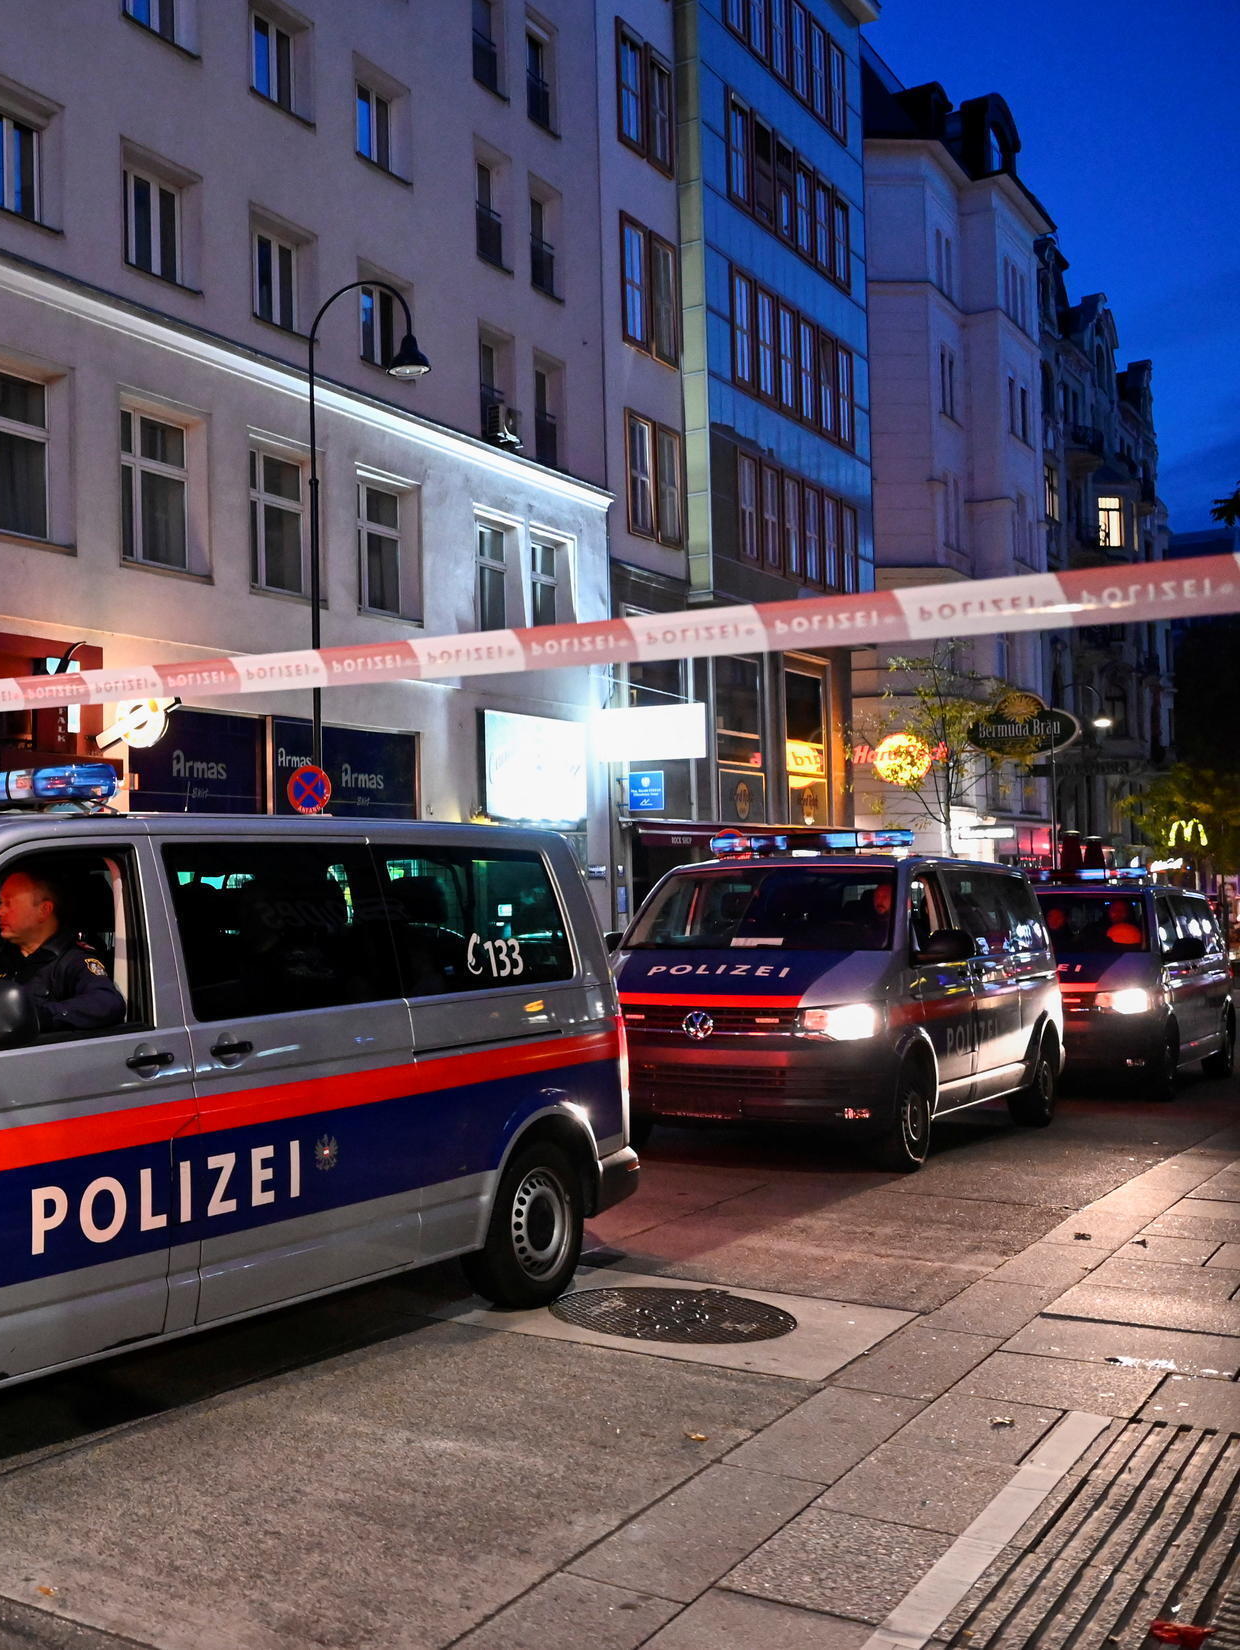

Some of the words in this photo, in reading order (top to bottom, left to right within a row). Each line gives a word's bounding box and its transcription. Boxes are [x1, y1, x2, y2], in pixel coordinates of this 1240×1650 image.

[978, 722, 1030, 739] Bermuda
[1033, 718, 1061, 735] Bräu
[172, 749, 228, 780] Armas
[277, 748, 312, 768] Armas
[341, 763, 385, 790] Armas
[483, 939, 524, 977] 133
[648, 963, 791, 978] POLIZEI
[946, 1018, 1000, 1057] POLIZEI
[31, 1140, 301, 1256] POLIZEI
